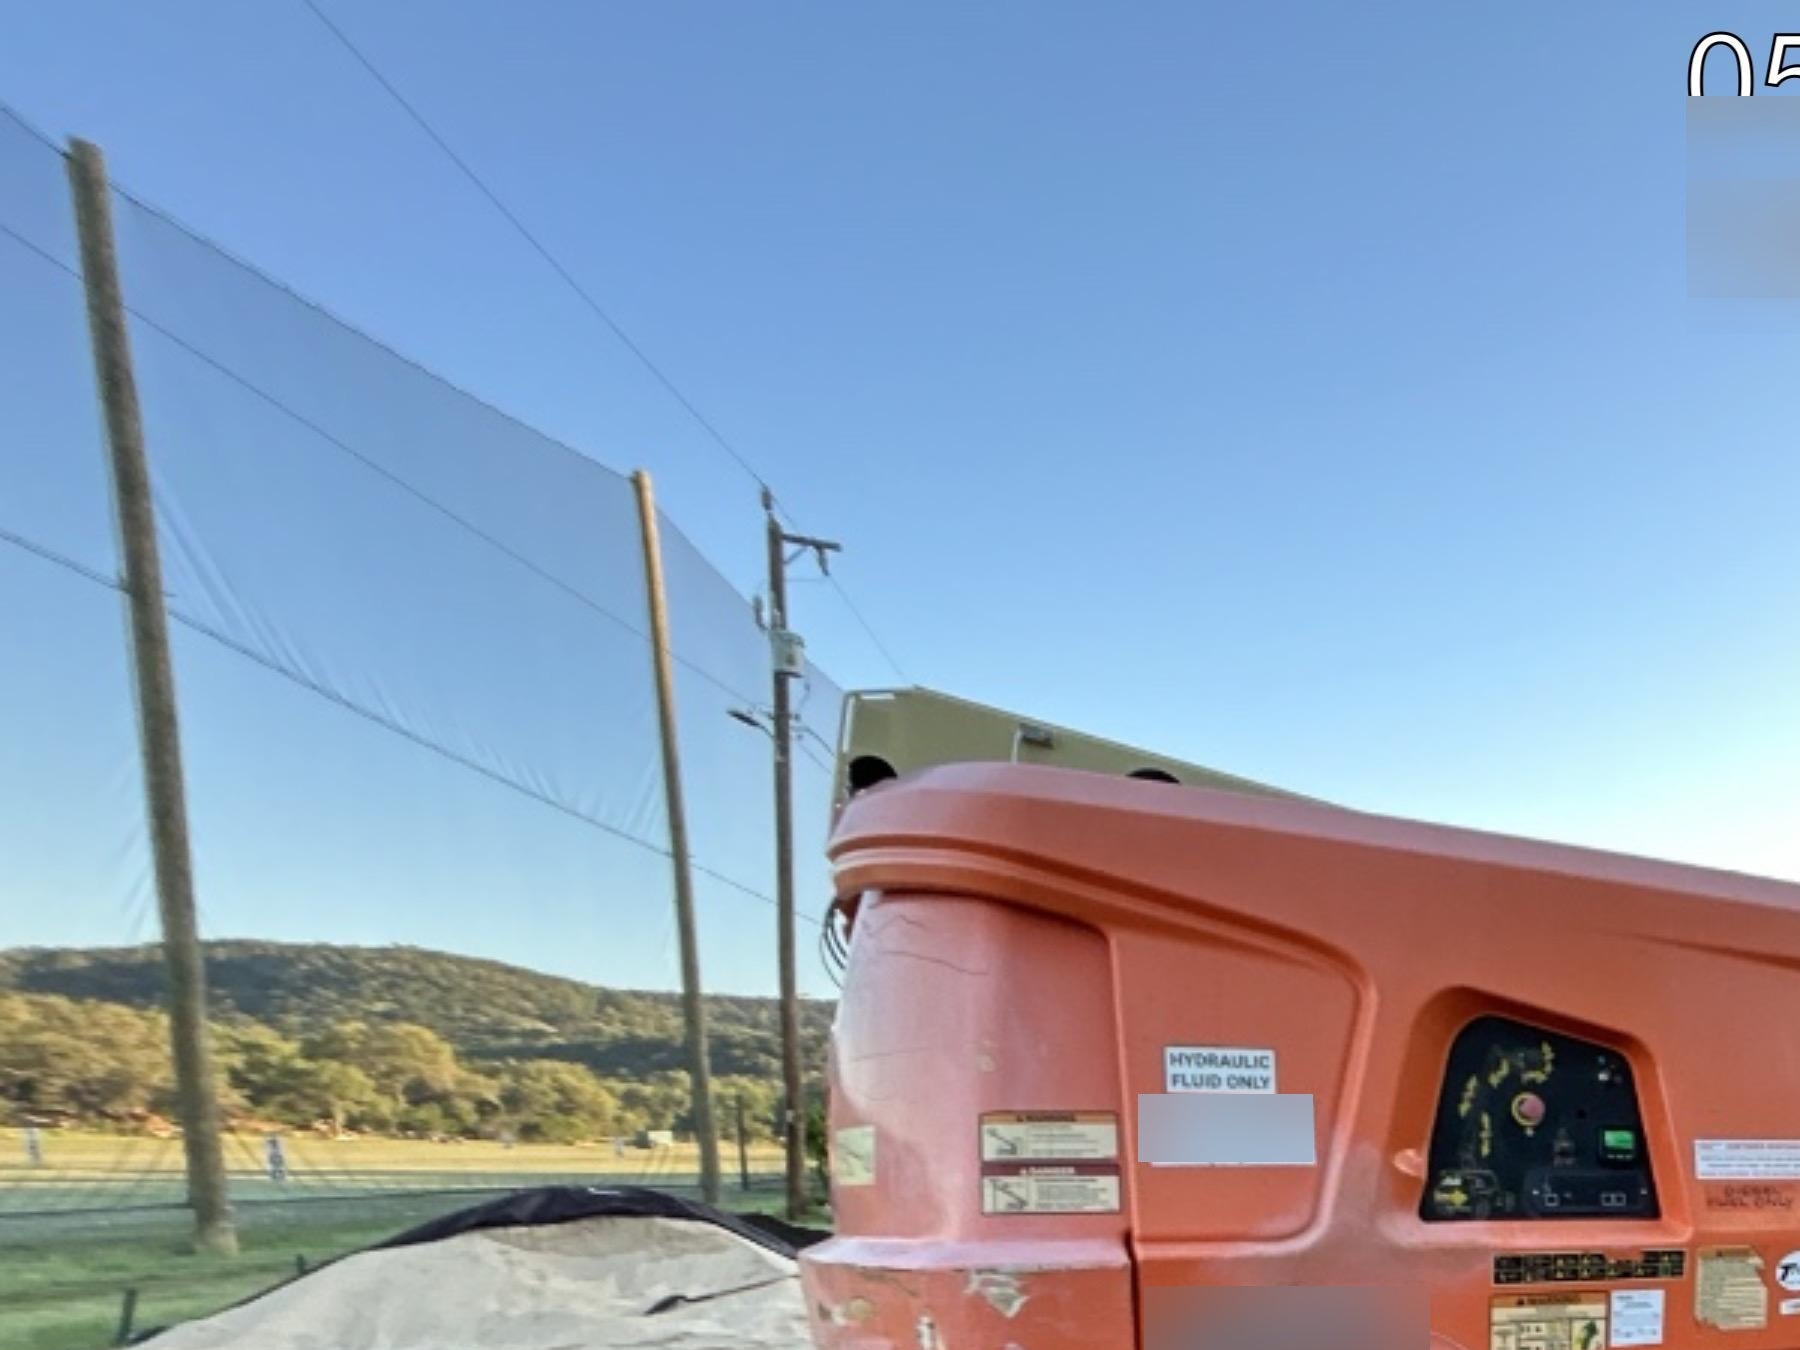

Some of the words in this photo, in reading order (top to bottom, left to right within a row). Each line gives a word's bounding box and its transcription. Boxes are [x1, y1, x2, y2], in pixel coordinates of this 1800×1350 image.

[1169, 1052, 1271, 1069] HYDRAULIC
[1172, 1073, 1222, 1089] FLUID
[1227, 1074, 1270, 1090] ONLY
